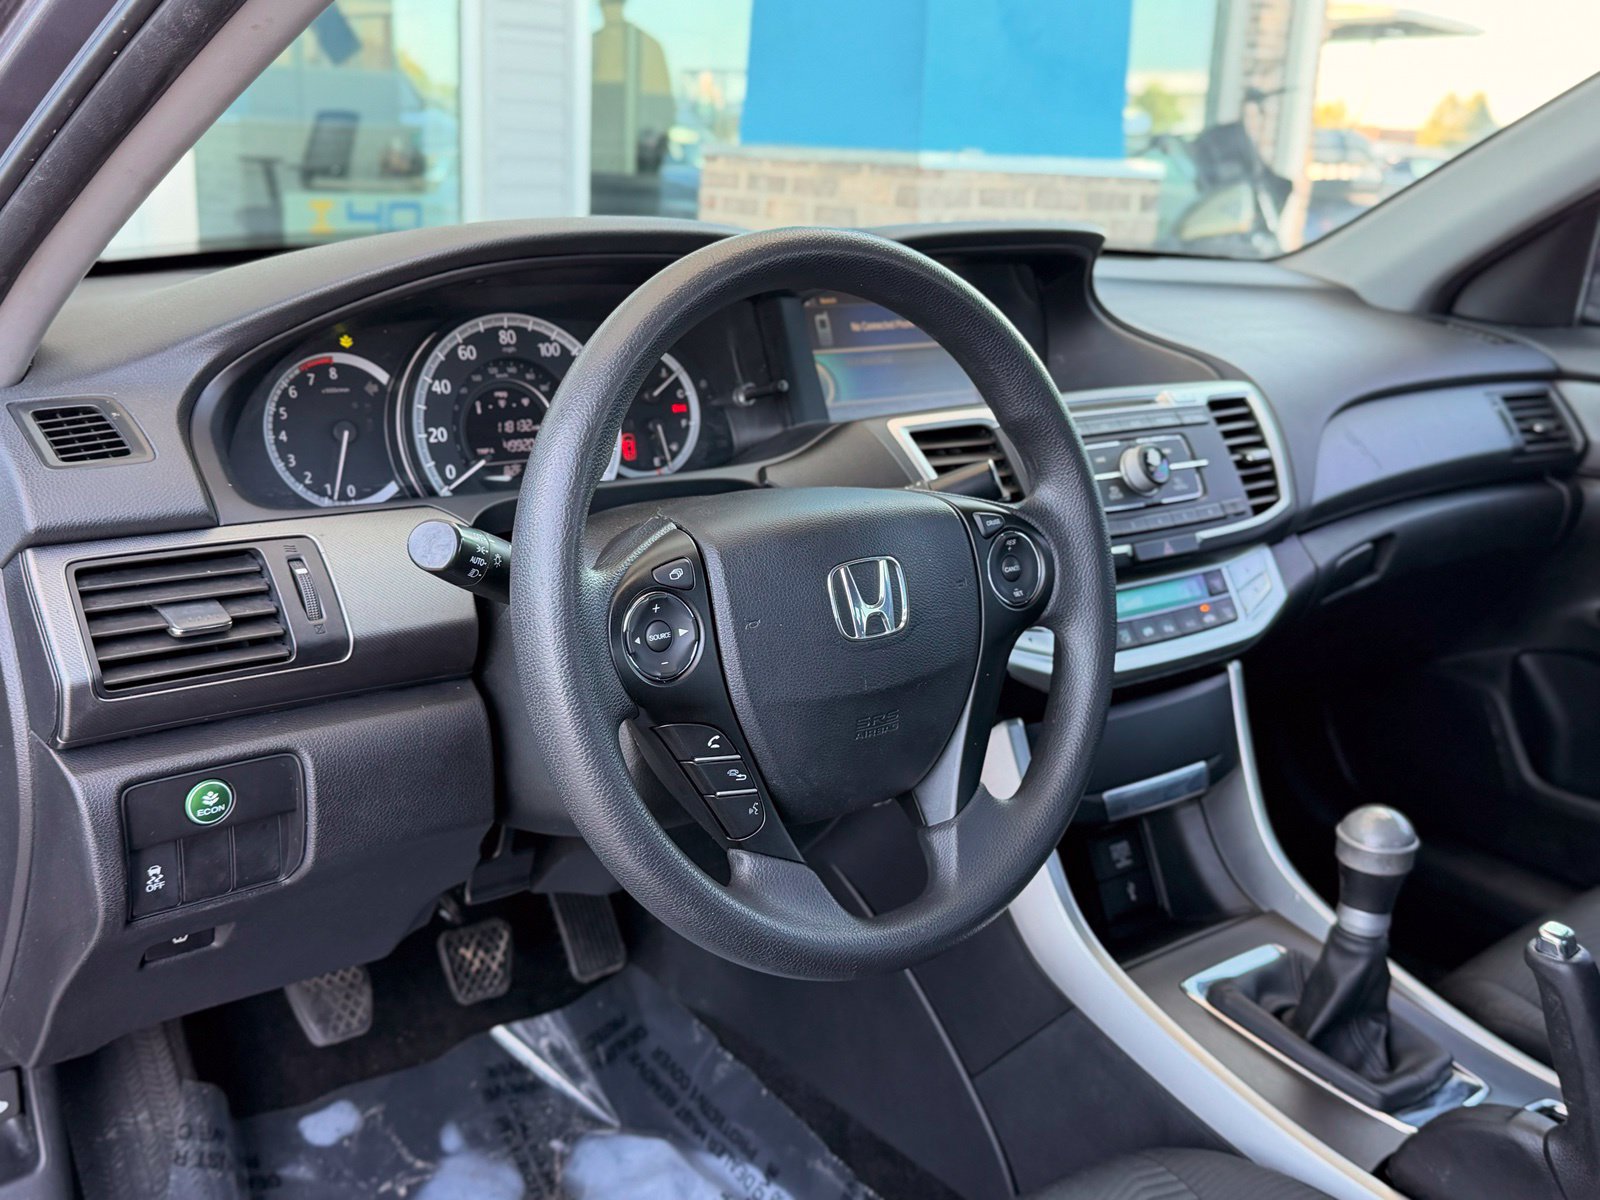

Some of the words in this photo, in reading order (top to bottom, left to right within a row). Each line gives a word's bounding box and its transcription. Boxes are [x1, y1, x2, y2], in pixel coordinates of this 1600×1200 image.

[498, 330, 516, 345] 80
[457, 345, 477, 360] 60
[538, 342, 560, 357] 100
[307, 374, 315, 386] 7
[328, 368, 338, 380] 8
[288, 386, 298, 398] 6
[431, 379, 452, 394] 40
[279, 407, 288, 420] 5
[278, 430, 288, 443] 4
[428, 427, 448, 443] 20
[287, 454, 296, 467] 3
[303, 472, 312, 484] 2
[445, 465, 456, 479] 0
[324, 483, 332, 495] 1
[346, 485, 356, 498] 0
[470, 556, 484, 566] AUTO
[649, 631, 671, 642] SOURCE
[856, 710, 900, 729] SRS
[196, 804, 226, 817] ECON
[146, 881, 165, 893] OFF
